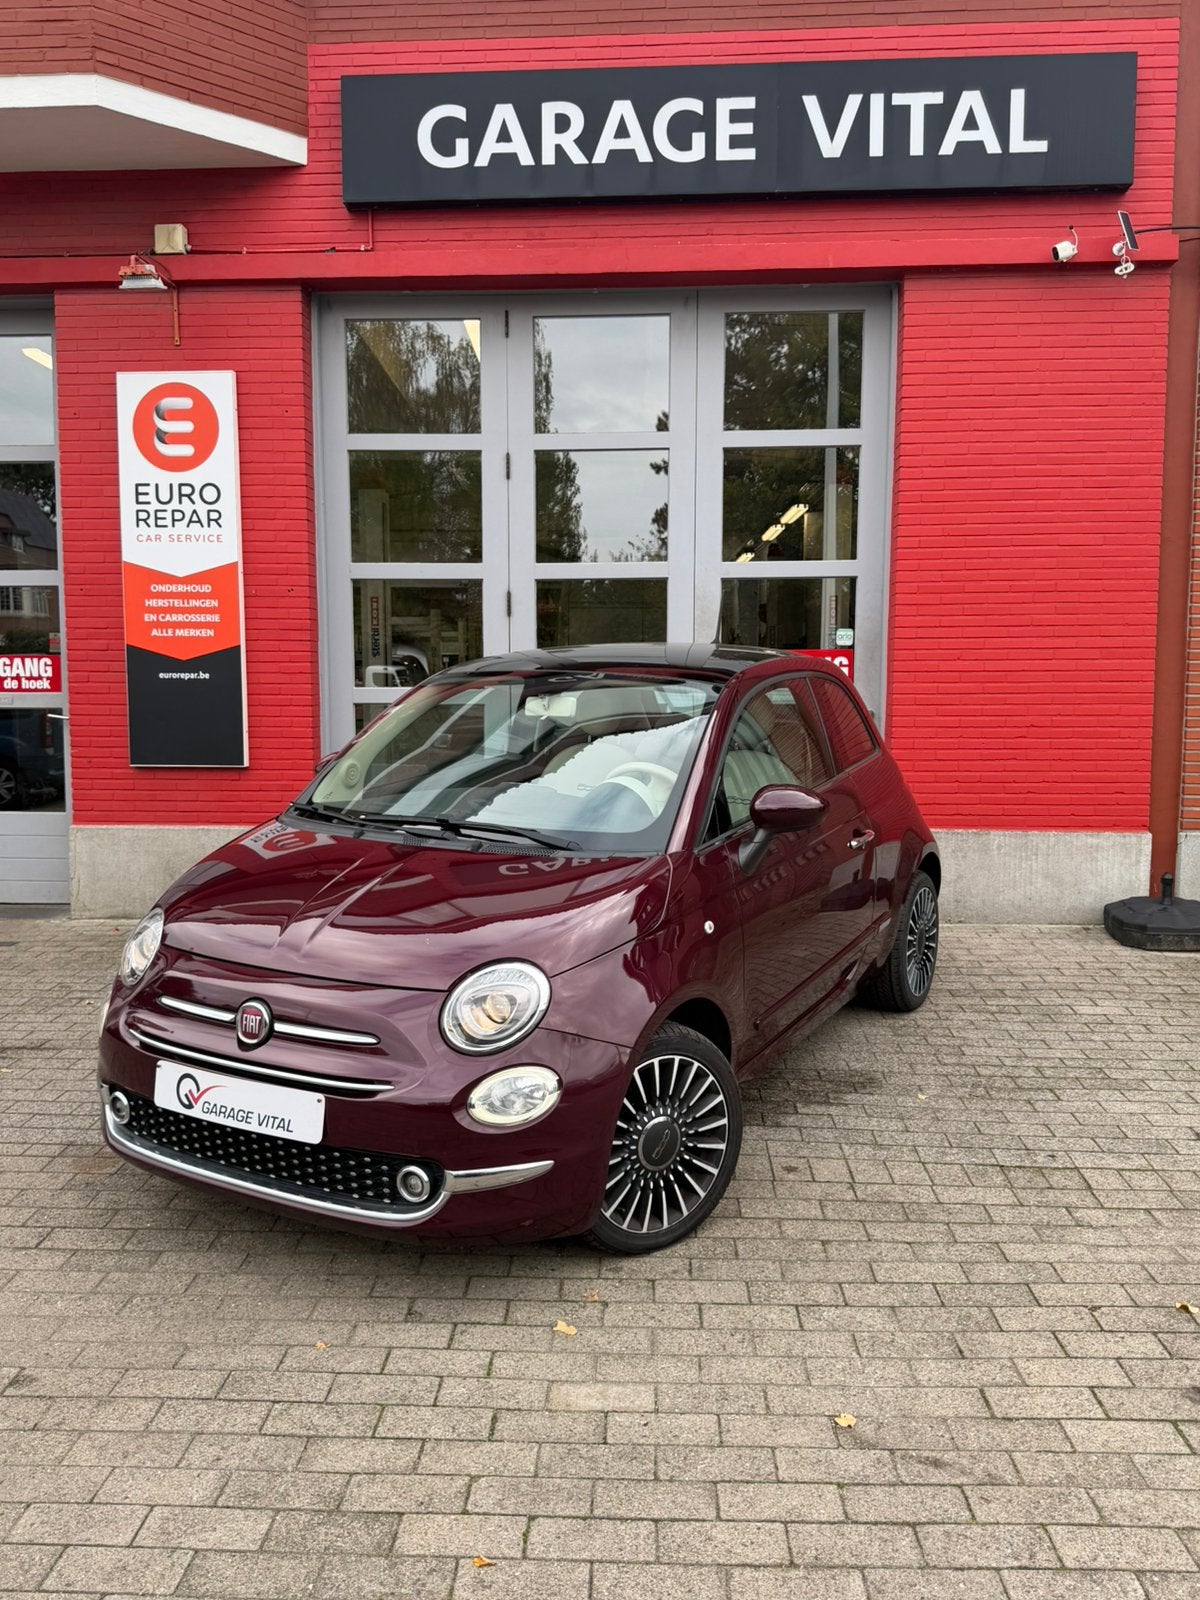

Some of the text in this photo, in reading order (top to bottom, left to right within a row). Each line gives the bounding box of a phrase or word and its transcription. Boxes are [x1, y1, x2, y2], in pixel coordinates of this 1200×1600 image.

[417, 88, 1049, 169] GARAGE VITAL
[135, 483, 221, 505] EURO
[135, 509, 222, 529] REPAR
[136, 534, 223, 543] CAR SERVICE
[150, 584, 212, 593] ONDERHOUD
[145, 599, 219, 608] HERSTELLINGEN
[144, 613, 221, 622] EN CARROSSERIE
[151, 628, 214, 637] ALLE MERKEN
[0, 657, 53, 677] GANG
[158, 671, 210, 680] eurorepar.be
[3, 677, 51, 690] de hoek
[242, 1013, 261, 1034] FIAT
[201, 1101, 294, 1133] GARAGE VITAL
